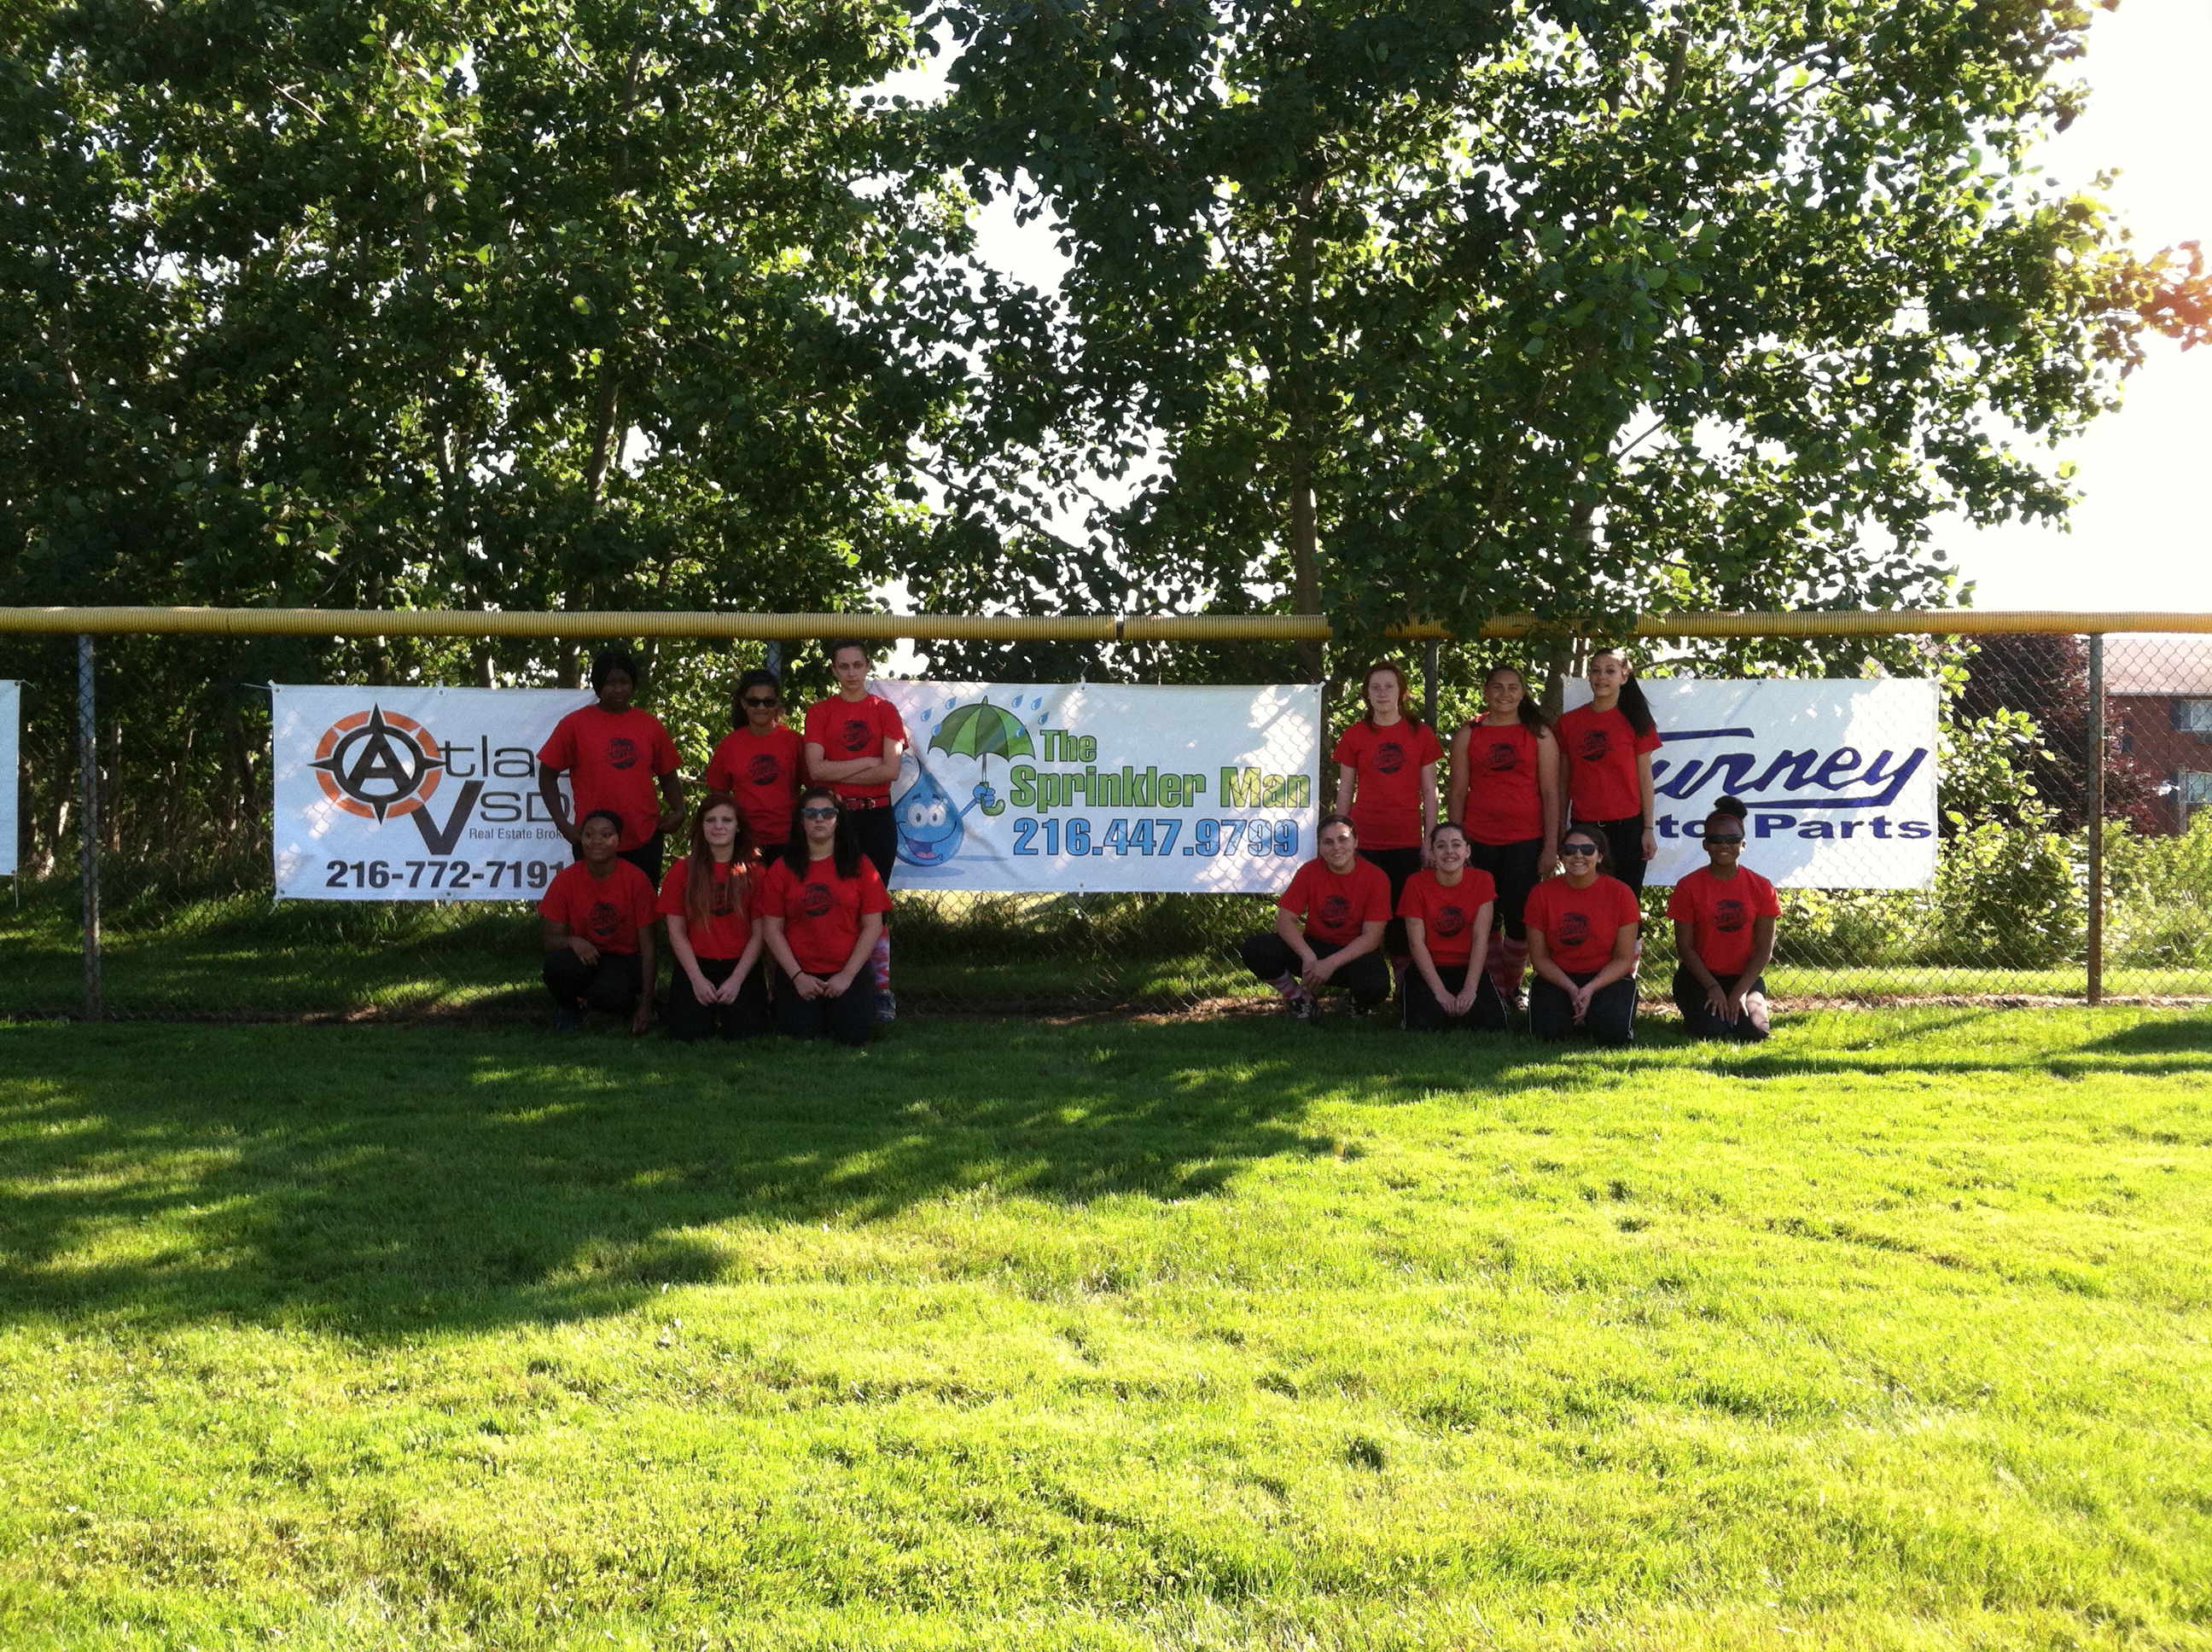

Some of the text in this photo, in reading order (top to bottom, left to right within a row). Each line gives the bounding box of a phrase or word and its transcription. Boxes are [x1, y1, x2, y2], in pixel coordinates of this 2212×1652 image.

[1039, 730, 1097, 763] The
[1010, 765, 1310, 813] Sprinkler Man
[469, 828, 566, 840] Real Estate Brok
[1012, 817, 1299, 857] 216.447.9799
[1755, 813, 1933, 839] Parts
